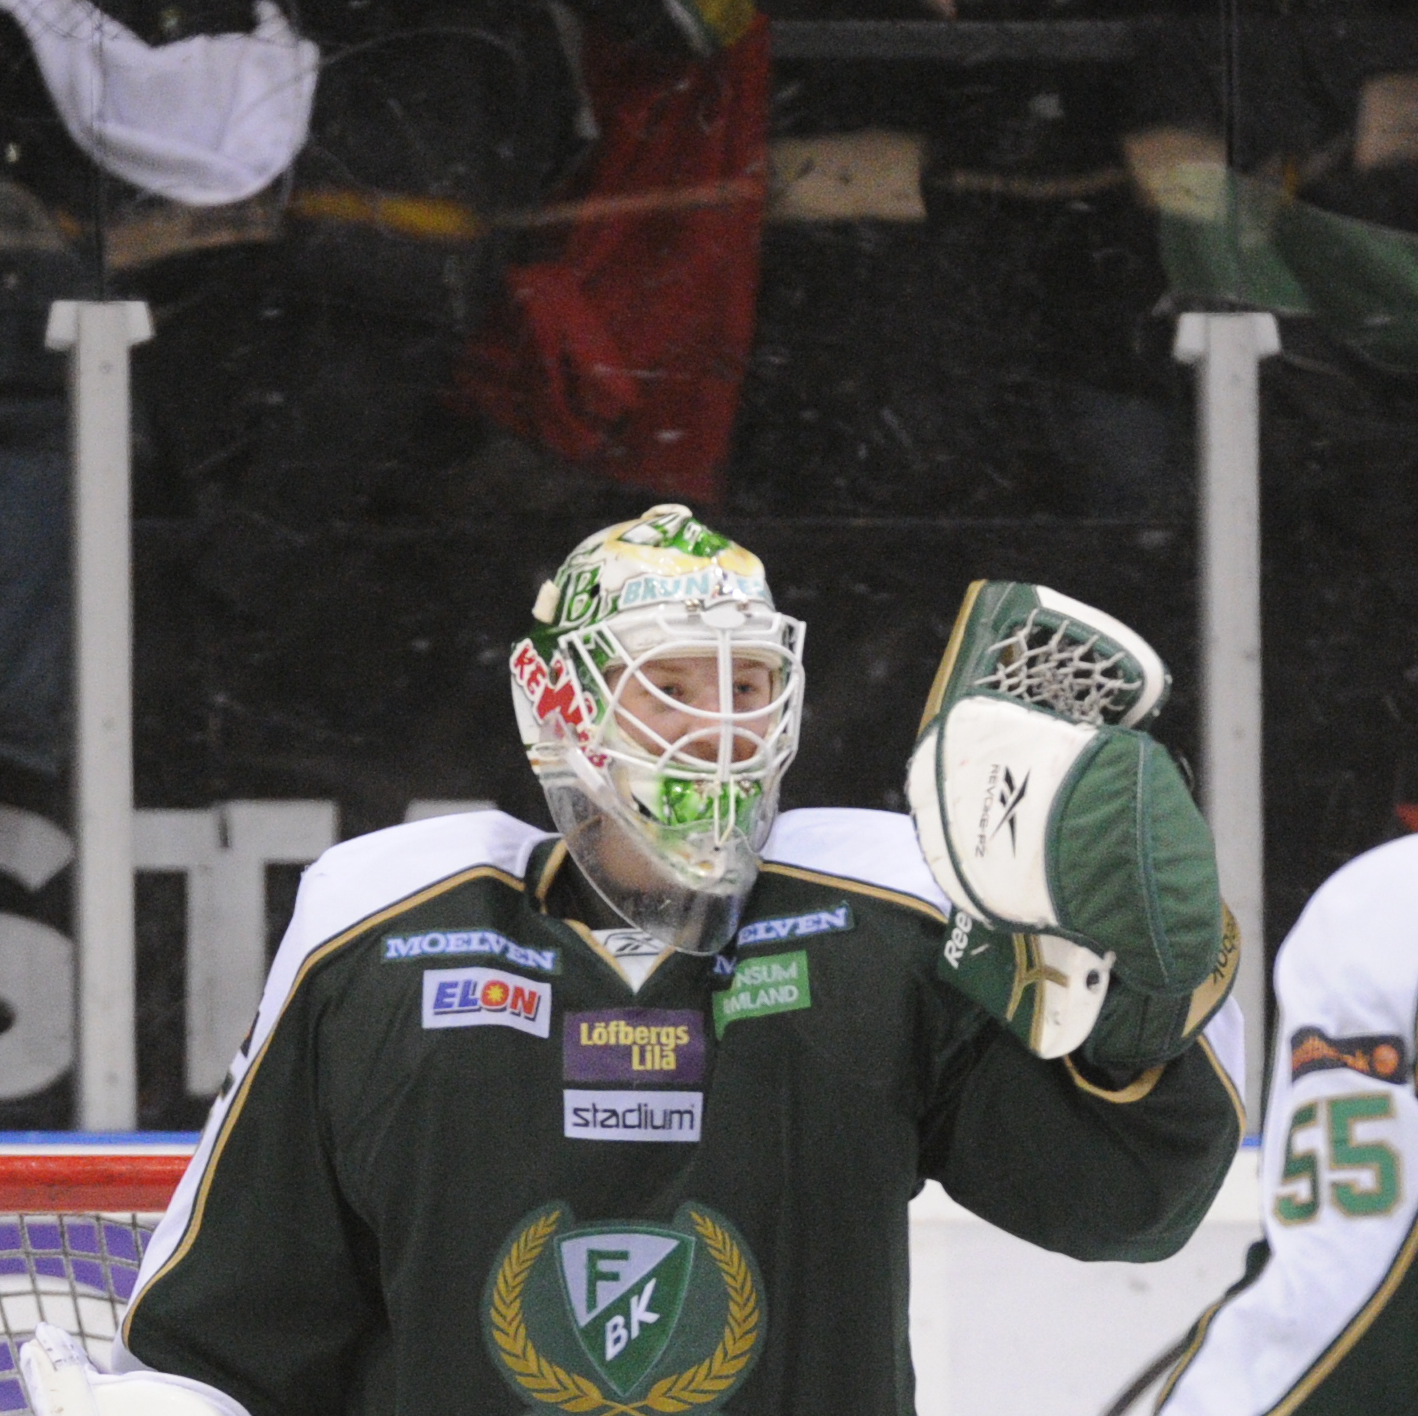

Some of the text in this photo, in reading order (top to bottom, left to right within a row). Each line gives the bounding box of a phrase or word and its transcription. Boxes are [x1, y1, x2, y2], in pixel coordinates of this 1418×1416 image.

[385, 930, 555, 971] MOELVEN
[944, 911, 972, 970] Ree
[735, 961, 798, 988] NSUM
[433, 979, 541, 1018] ELON
[580, 1020, 690, 1051] Löfbergs
[631, 1044, 677, 1072] Lila
[571, 1102, 696, 1131] stadium
[1273, 1090, 1404, 1228] 55
